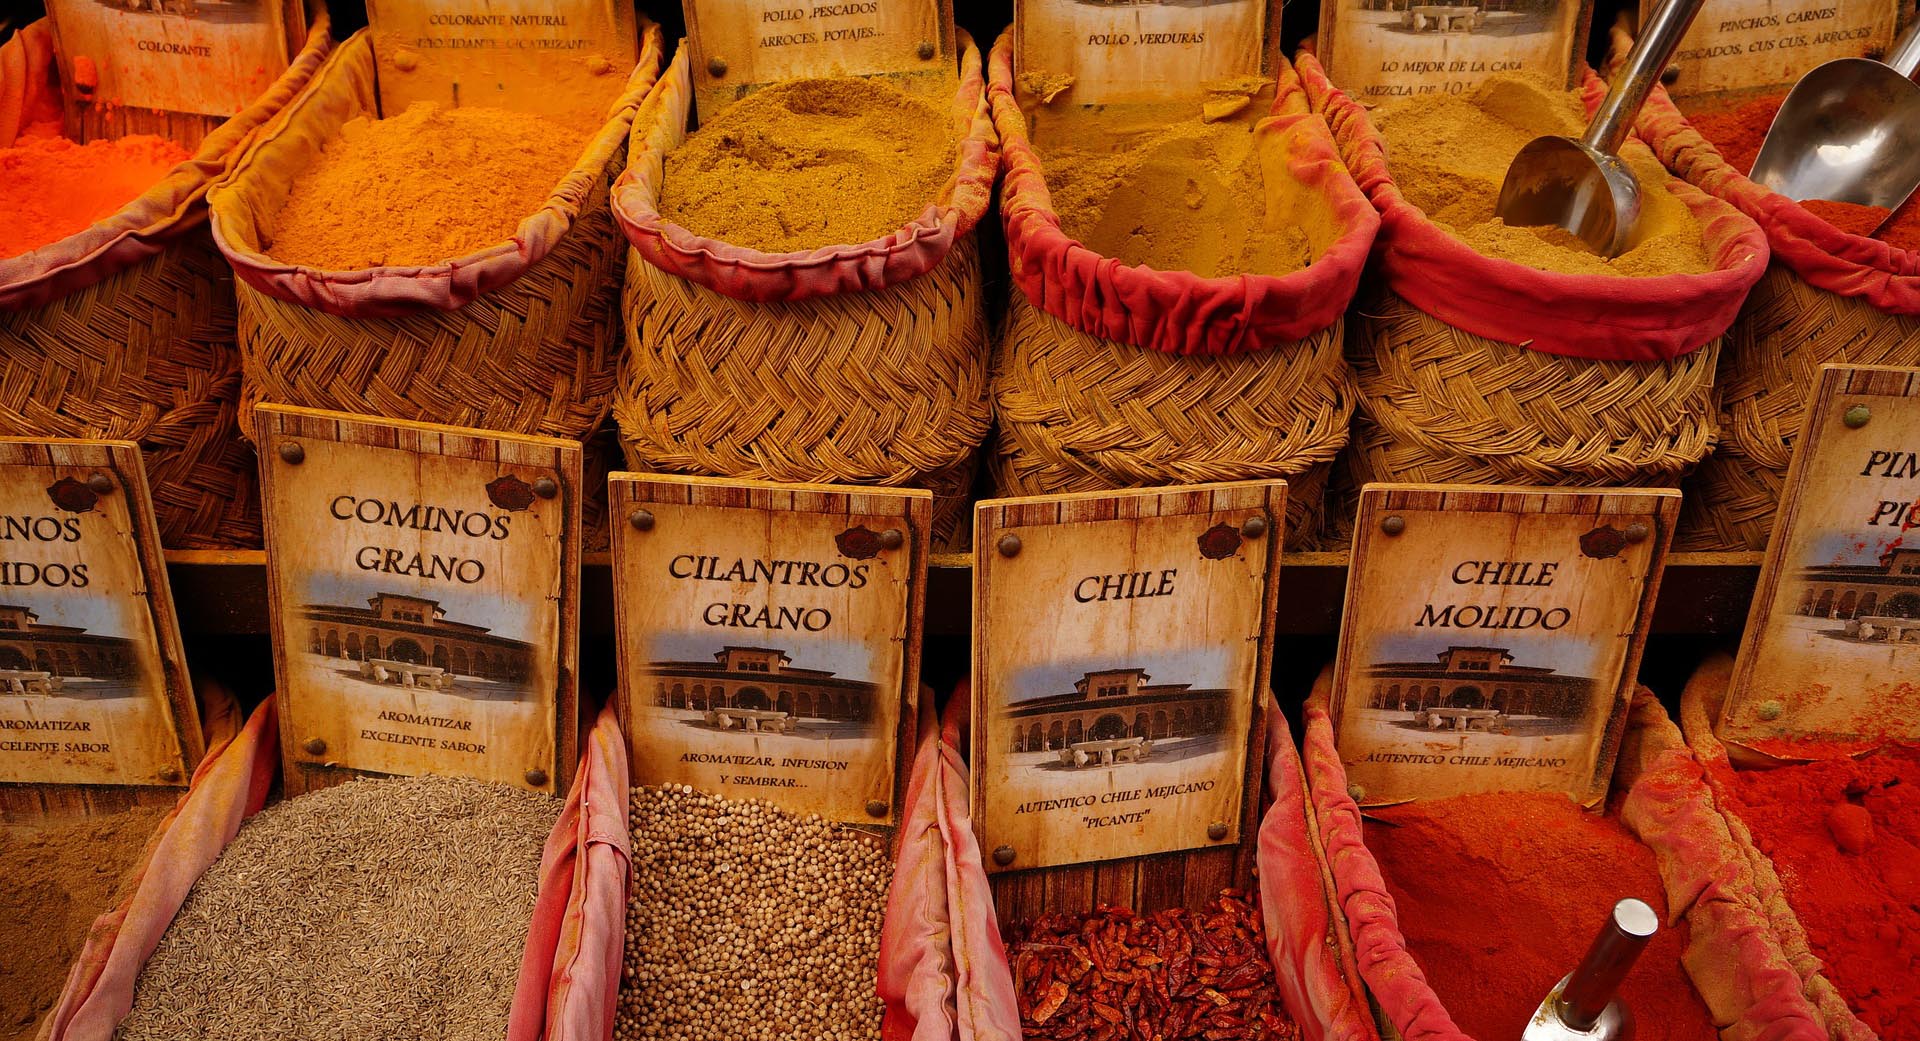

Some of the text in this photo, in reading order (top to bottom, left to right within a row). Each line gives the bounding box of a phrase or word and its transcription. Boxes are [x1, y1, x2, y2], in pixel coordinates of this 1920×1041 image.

[429, 14, 568, 27] COLORANTE NATURAL
[763, 8, 804, 23] POLLO
[1719, 7, 1837, 33] PINCHOS, CARNES
[137, 40, 212, 57] COLORANTE
[758, 26, 885, 48] ARROCES, POTAJES...
[1088, 33, 1130, 46] POLLO
[1676, 26, 1873, 61] PESCADOS, CUS CUS, ARROCES
[1381, 61, 1523, 76] LO MEJOR DE LA CASA
[1362, 85, 1413, 97] MEZCLA
[0, 515, 82, 543] NOS
[329, 494, 511, 541] COMINOS
[355, 546, 485, 584] GRANO
[668, 554, 869, 589] CILANTROS
[1451, 560, 1559, 588] CHILE
[1074, 569, 1177, 604] CHILE
[702, 602, 832, 632] GRANO
[1414, 603, 1571, 631] MOLIDO
[377, 709, 473, 732] AROMATIZAR
[64, 743, 111, 753] SABOR
[360, 729, 487, 755] EXCELENTE SABOR
[679, 752, 849, 771] AROMATIZAR, INFUSION
[1365, 751, 1567, 770] AUTENTICO CHILE MEJICANO
[719, 774, 809, 789] Y SEMBRAR...
[1015, 779, 1216, 816] AUTENTICO CHILE MEJICANO
[1081, 808, 1152, 830] "PICANTE"
